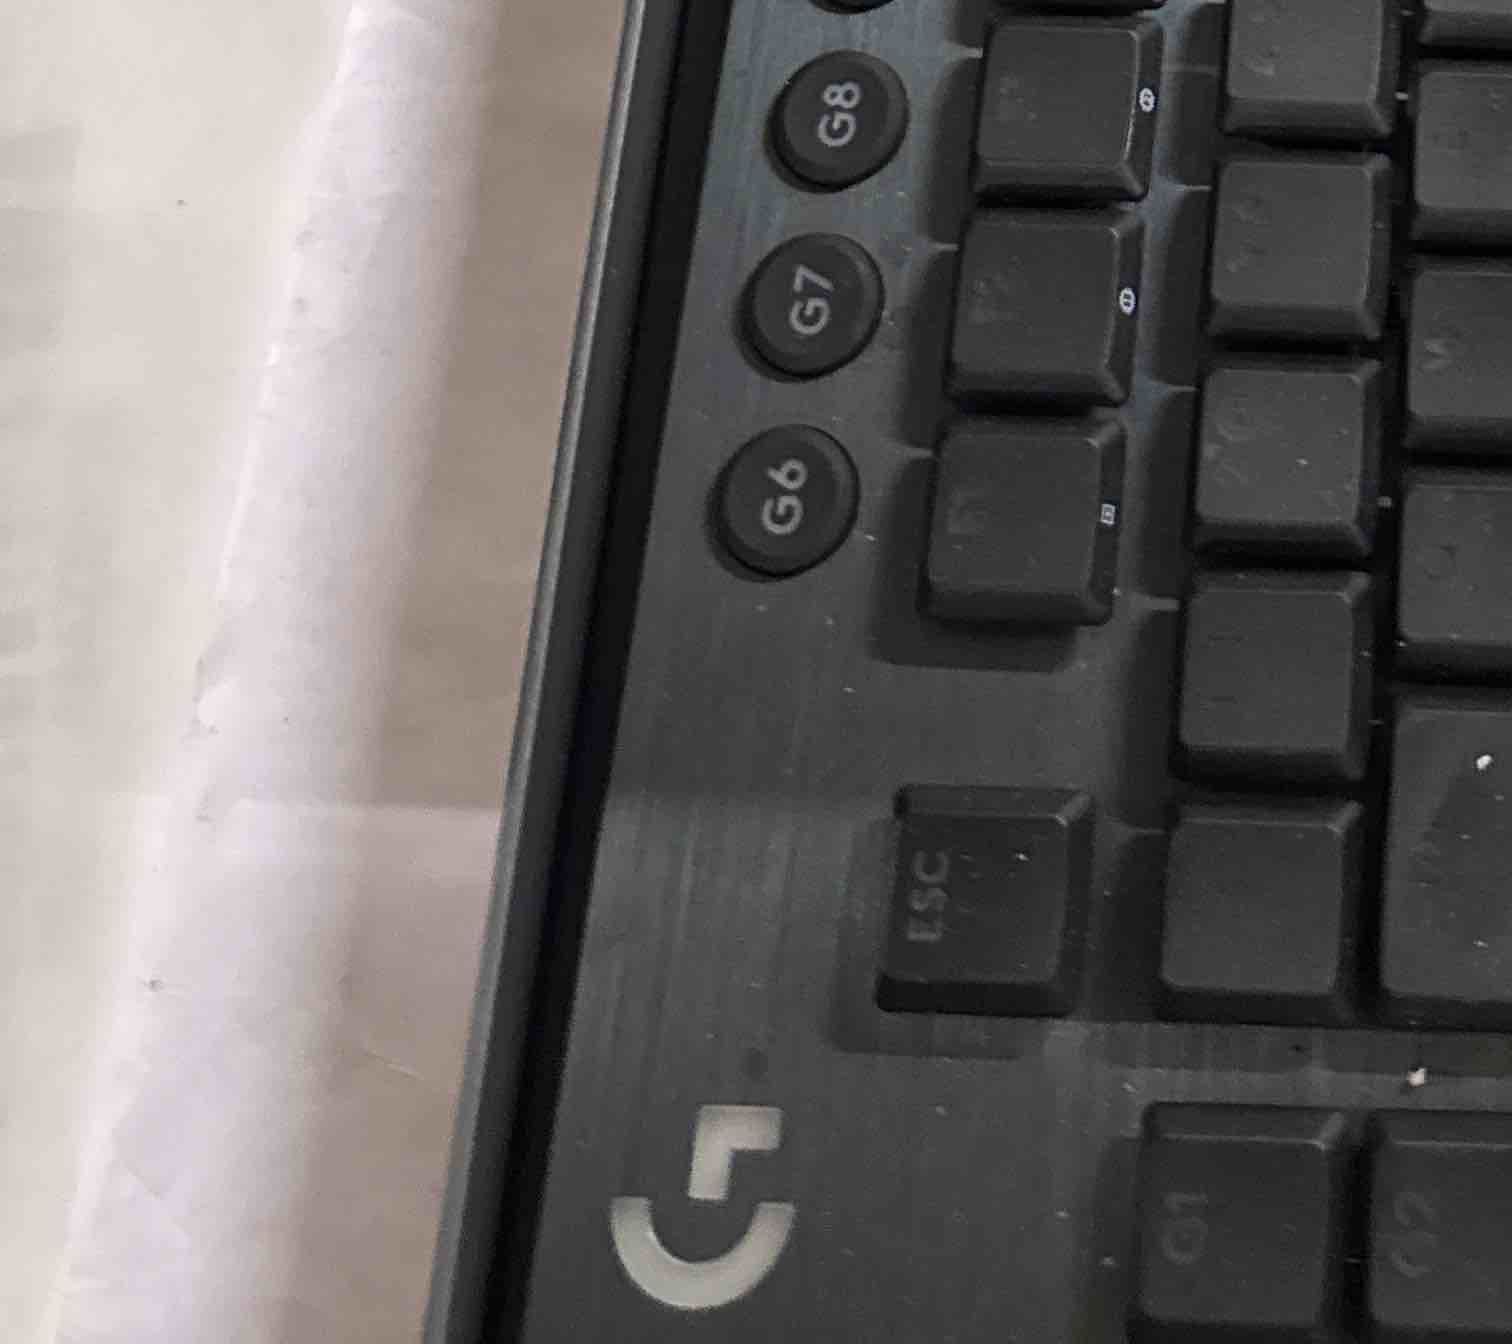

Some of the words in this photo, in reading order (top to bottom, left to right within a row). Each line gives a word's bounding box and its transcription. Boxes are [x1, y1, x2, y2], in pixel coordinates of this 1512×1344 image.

[817, 81, 862, 148] G8
[788, 264, 835, 337] G7
[760, 458, 808, 536] G6
[906, 849, 951, 943] ESC
